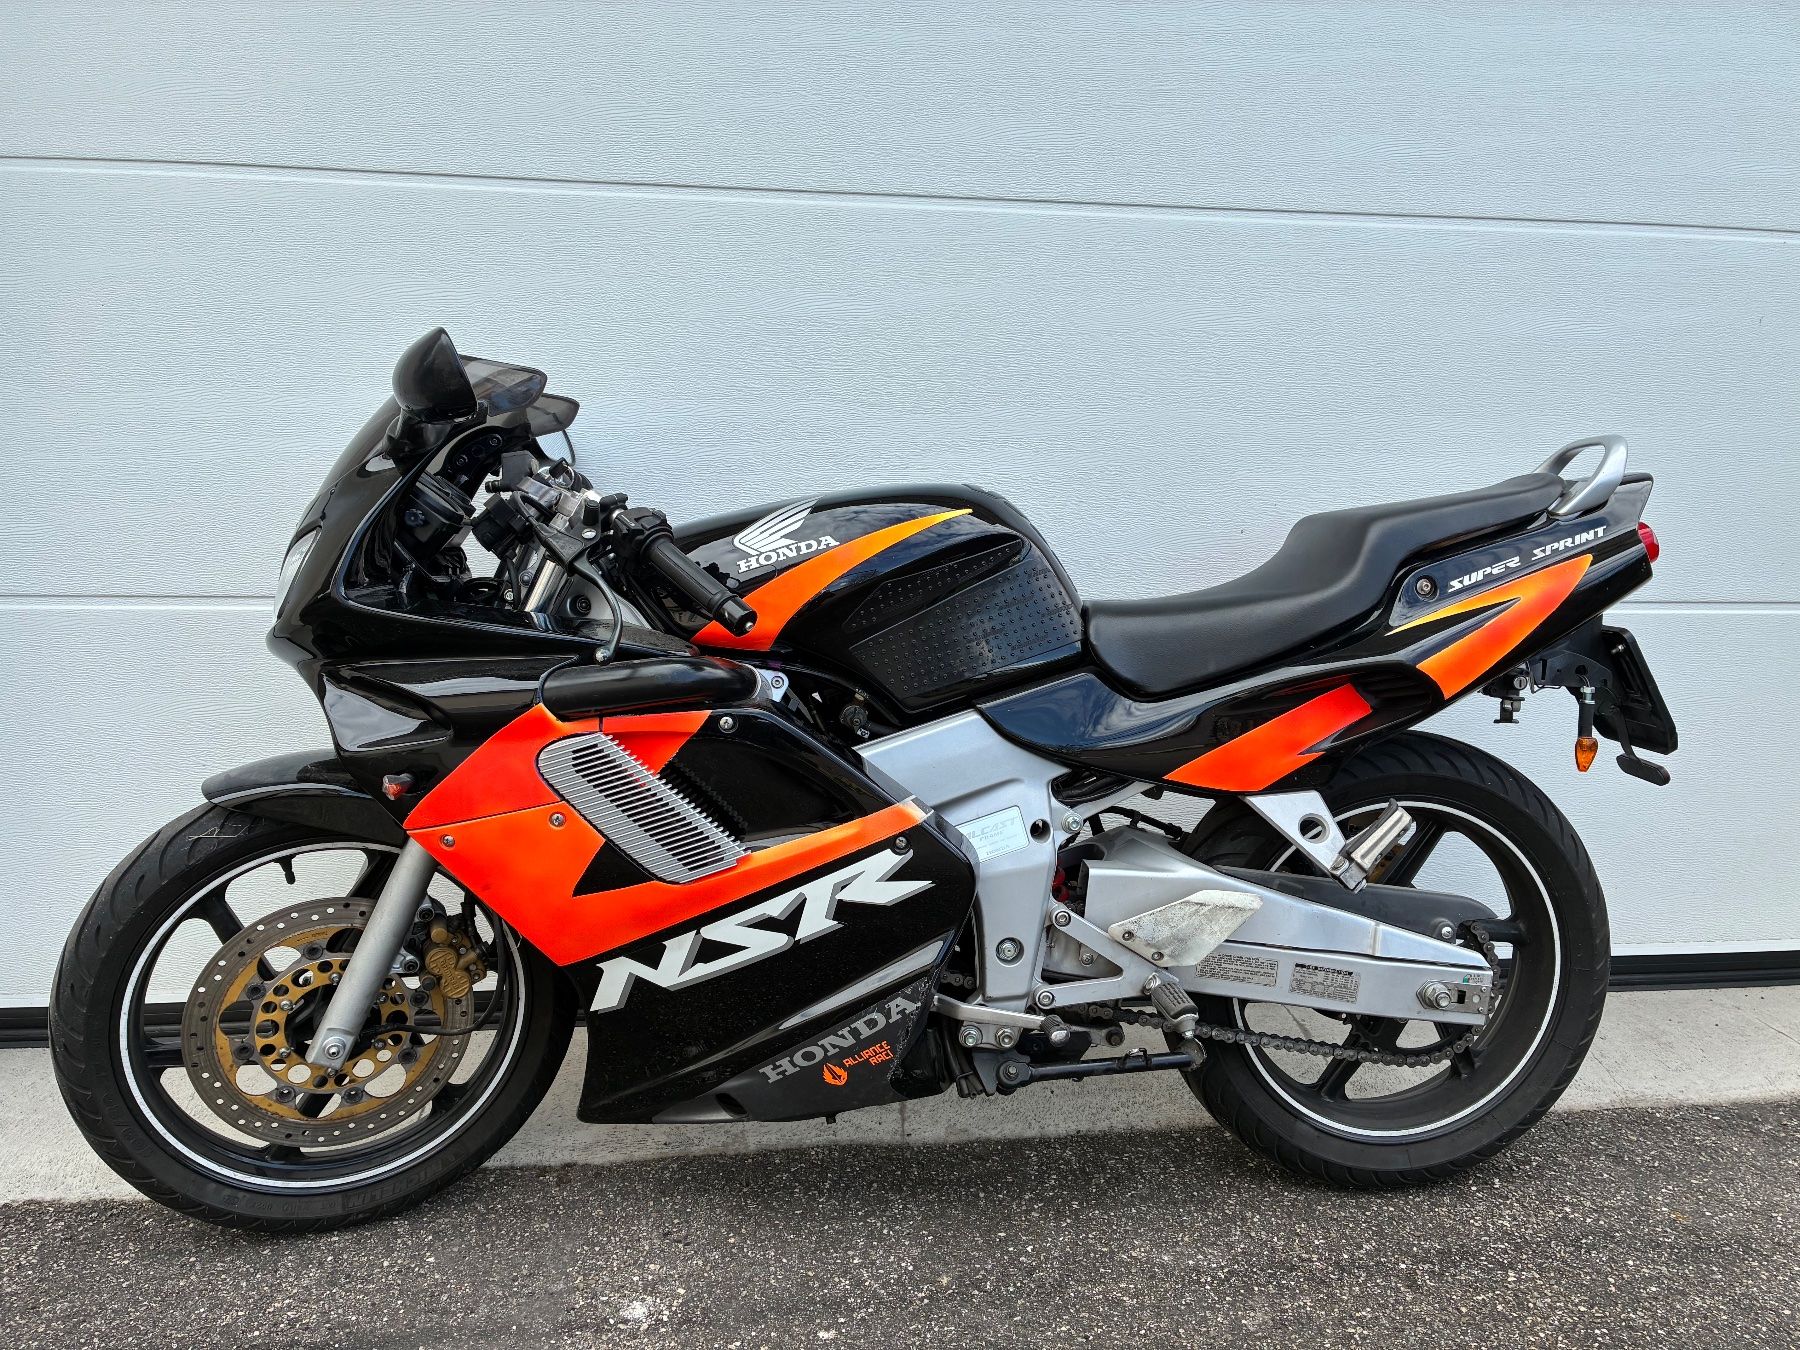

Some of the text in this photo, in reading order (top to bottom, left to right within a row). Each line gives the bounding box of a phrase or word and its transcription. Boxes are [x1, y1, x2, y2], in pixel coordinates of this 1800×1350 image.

[737, 535, 840, 574] HONDA
[1448, 525, 1607, 593] SUPER SPRINT
[589, 849, 935, 1014] NSR
[758, 996, 922, 1084] HONDA
[842, 1040, 891, 1067] ALLIANCE
